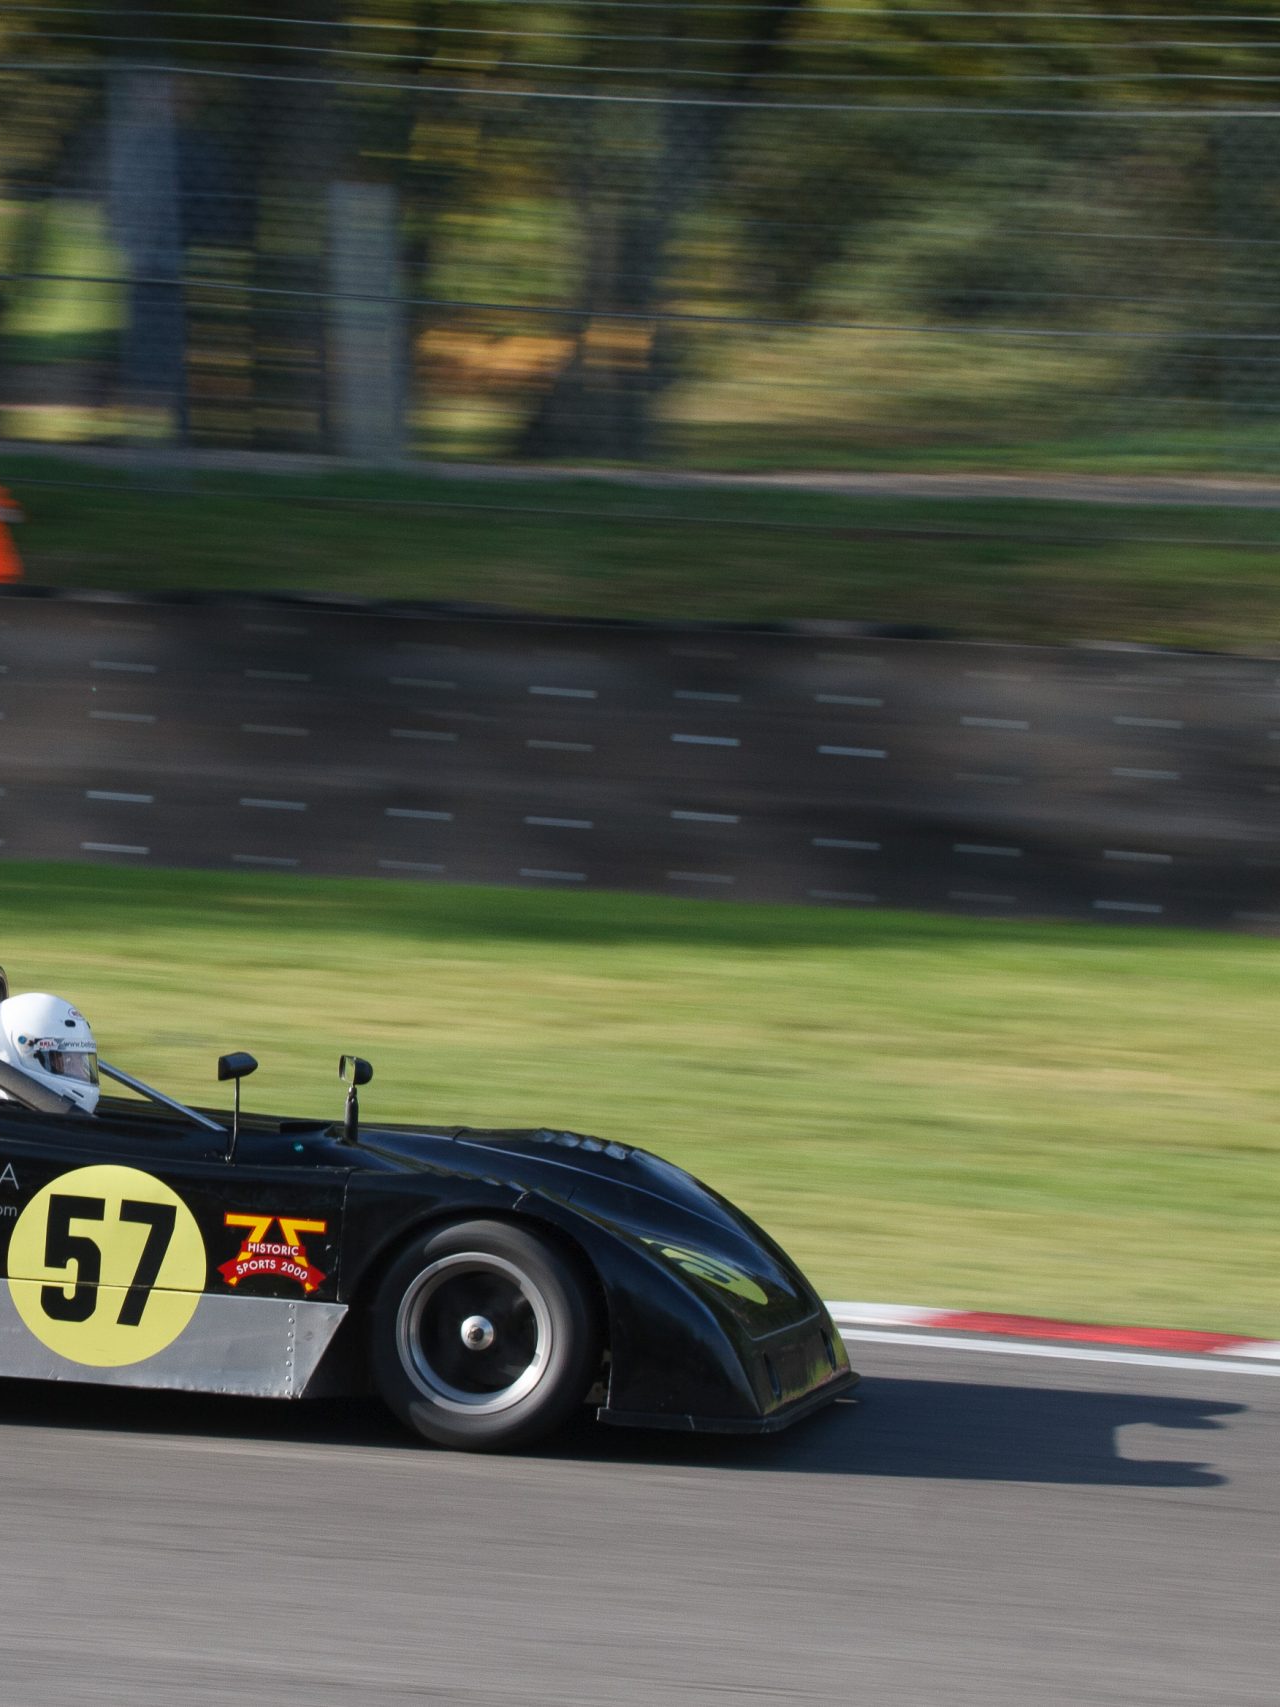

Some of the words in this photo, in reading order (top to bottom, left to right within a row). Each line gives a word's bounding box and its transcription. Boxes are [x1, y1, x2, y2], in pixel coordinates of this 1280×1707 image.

[247, 1242, 299, 1256] HISTORIC
[40, 1193, 177, 1327] 57
[236, 1260, 276, 1275] SPORTS
[280, 1262, 308, 1280] 2000
